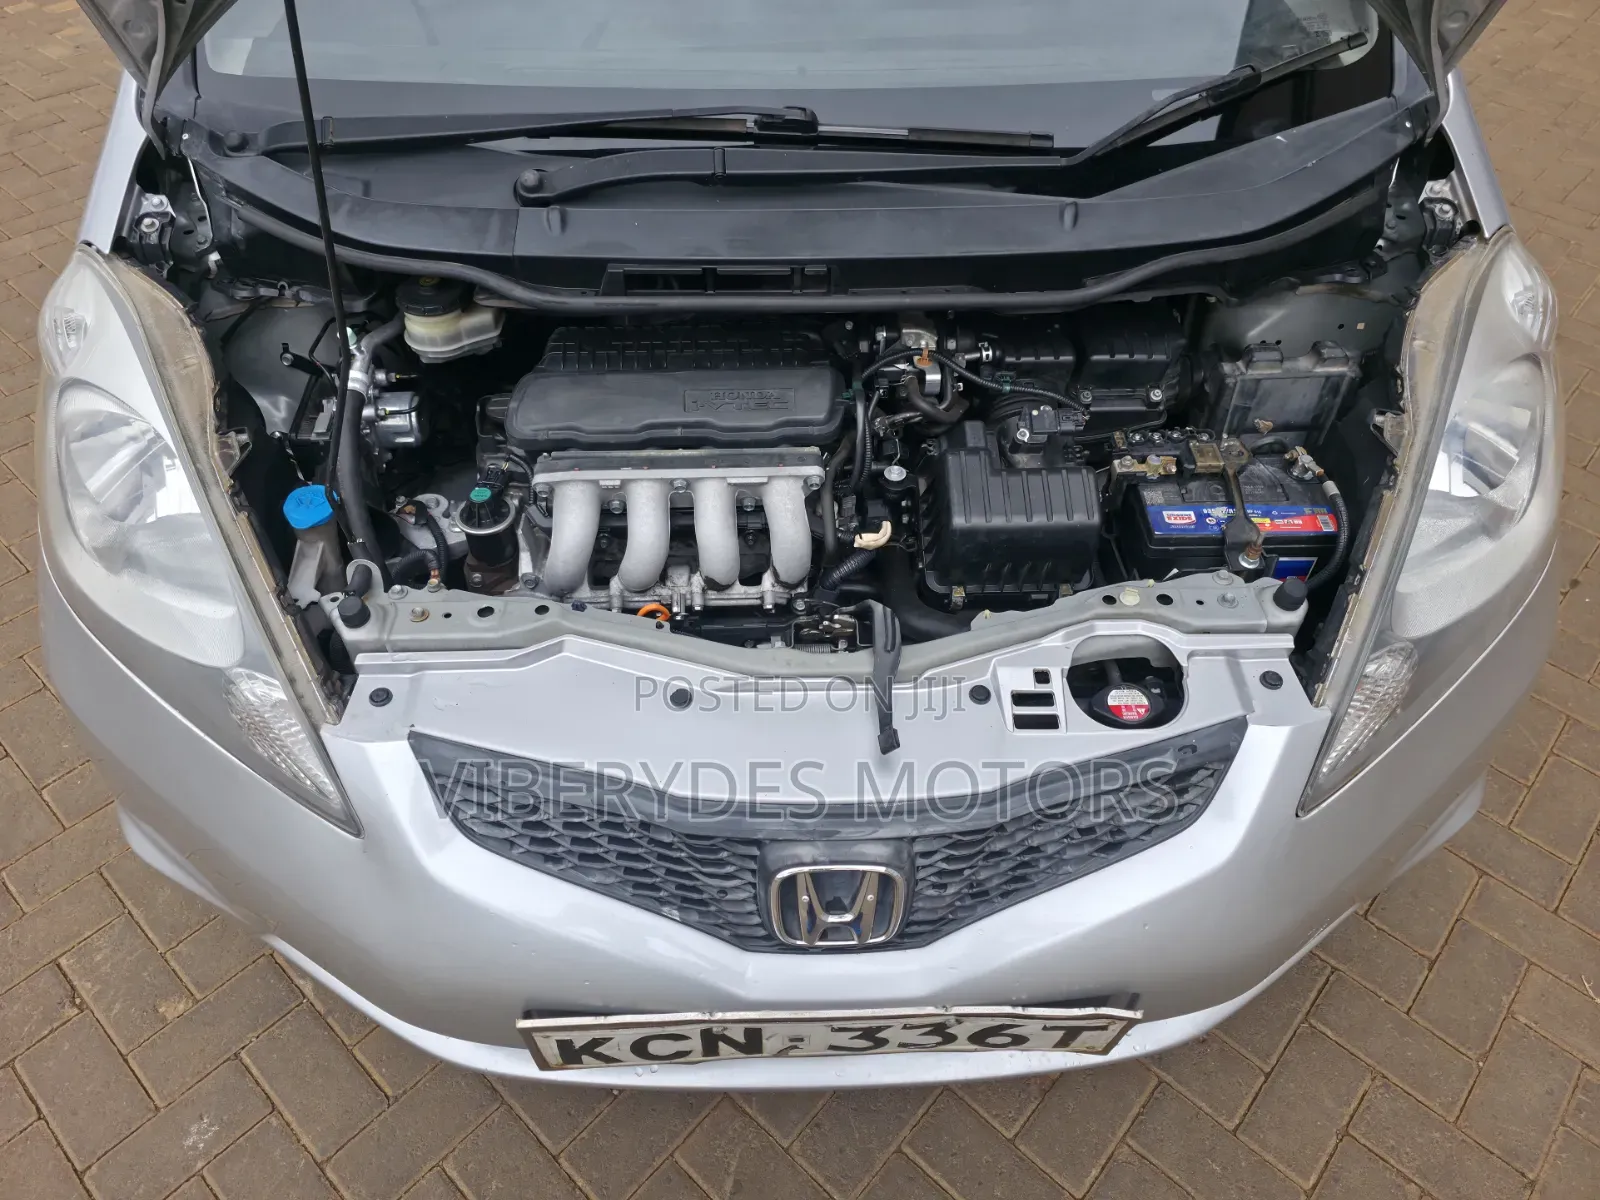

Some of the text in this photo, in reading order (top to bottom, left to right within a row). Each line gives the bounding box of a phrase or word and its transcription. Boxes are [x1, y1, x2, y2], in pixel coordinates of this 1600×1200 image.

[710, 391, 781, 401] HONDA
[555, 1021, 1110, 1065] KCN 336T
